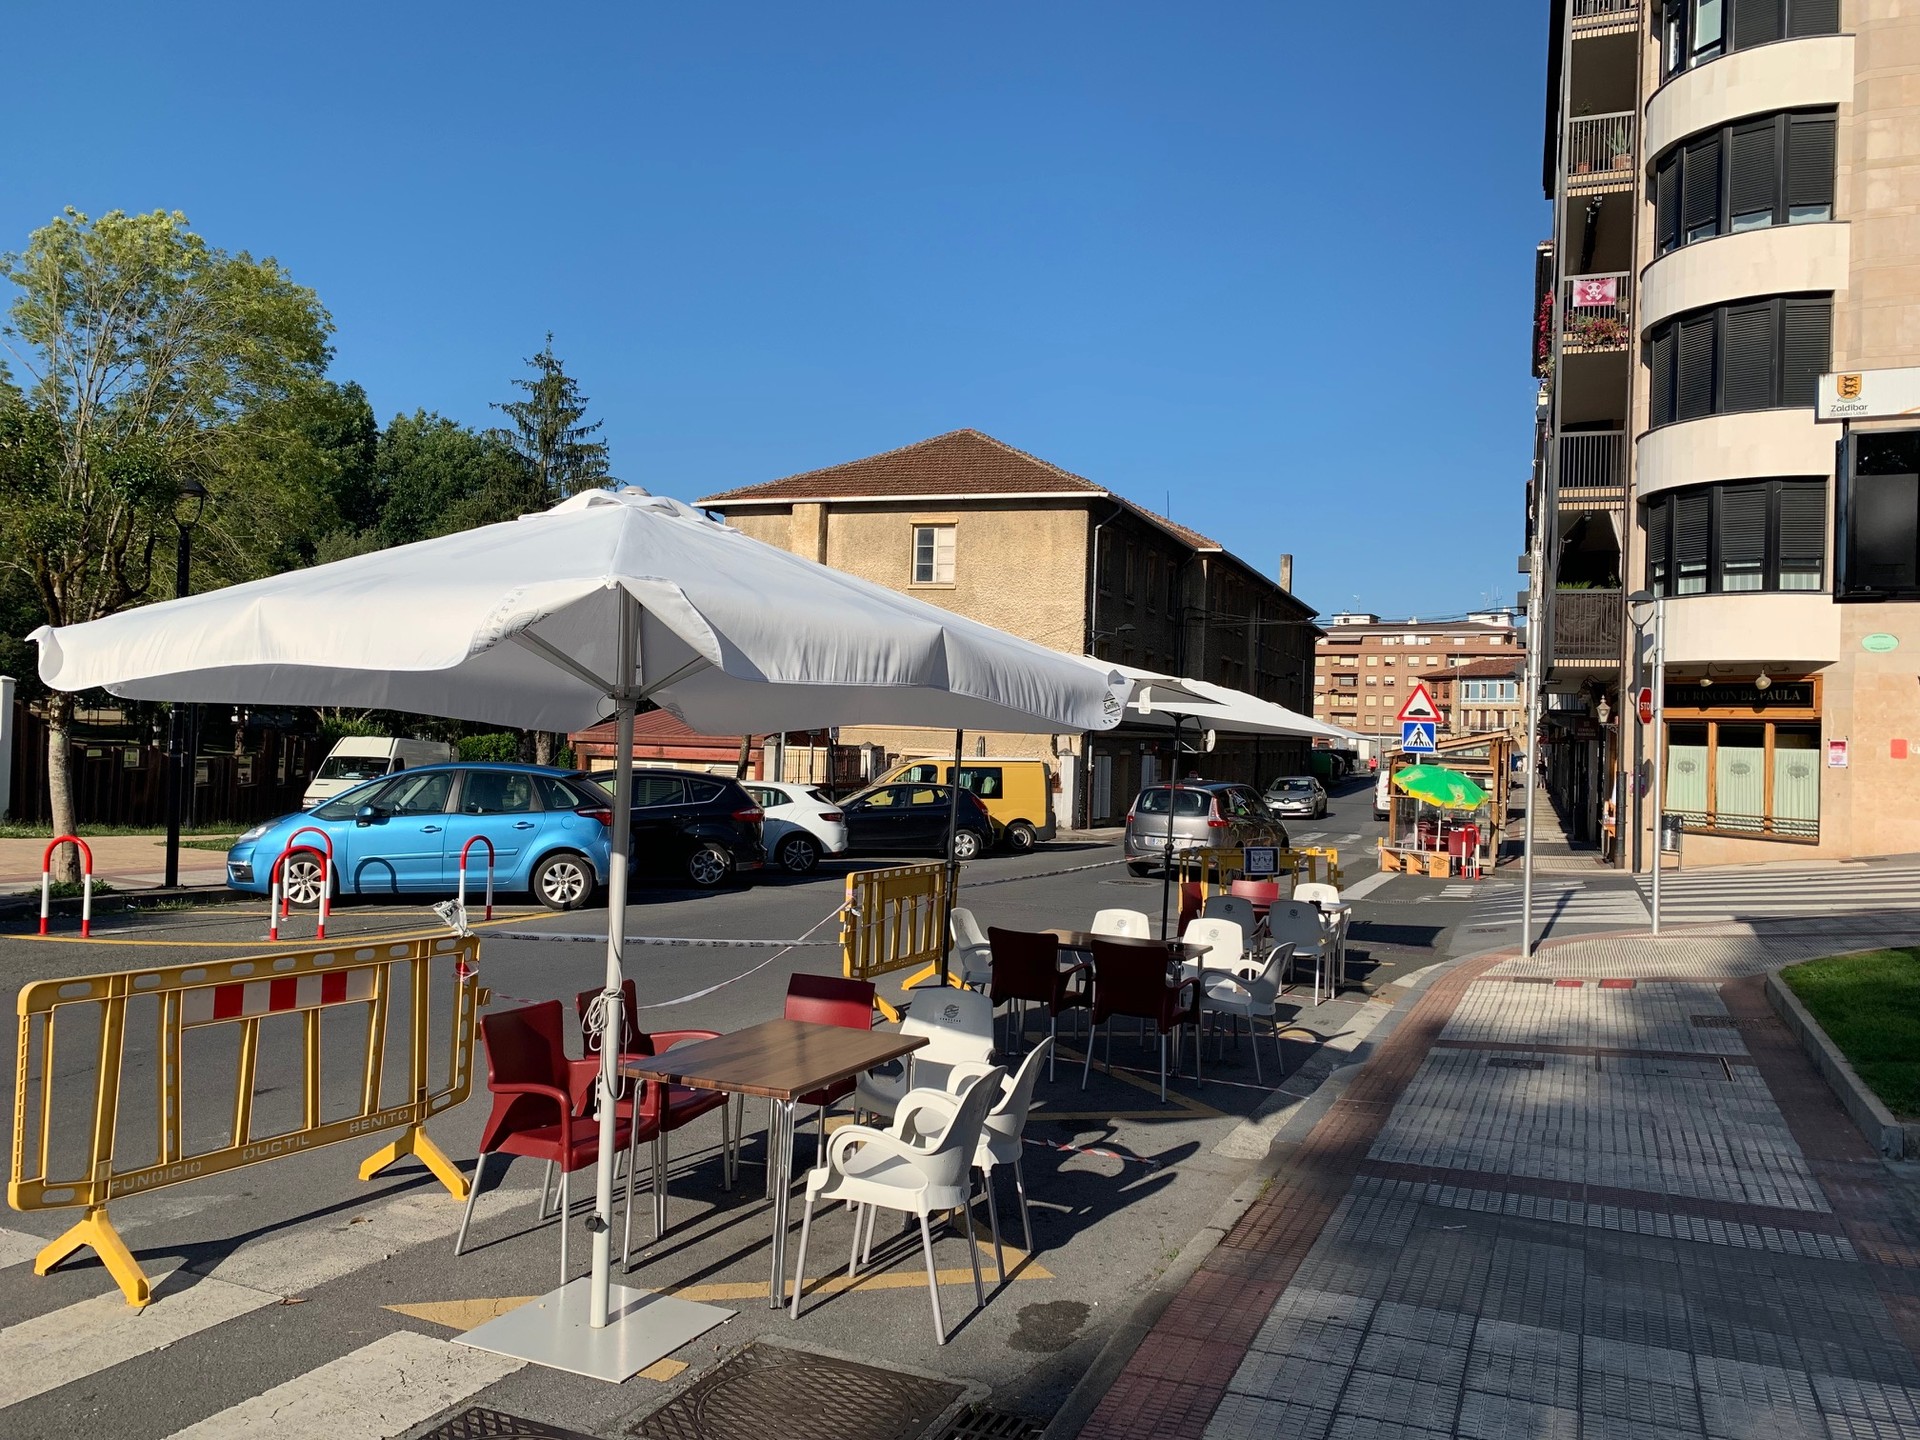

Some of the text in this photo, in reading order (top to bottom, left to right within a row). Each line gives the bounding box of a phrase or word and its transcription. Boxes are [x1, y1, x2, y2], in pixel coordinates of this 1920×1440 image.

[1830, 404, 1869, 412] Zaldibar
[1759, 690, 1801, 701] PAULA
[242, 1135, 310, 1160] DUCTIL
